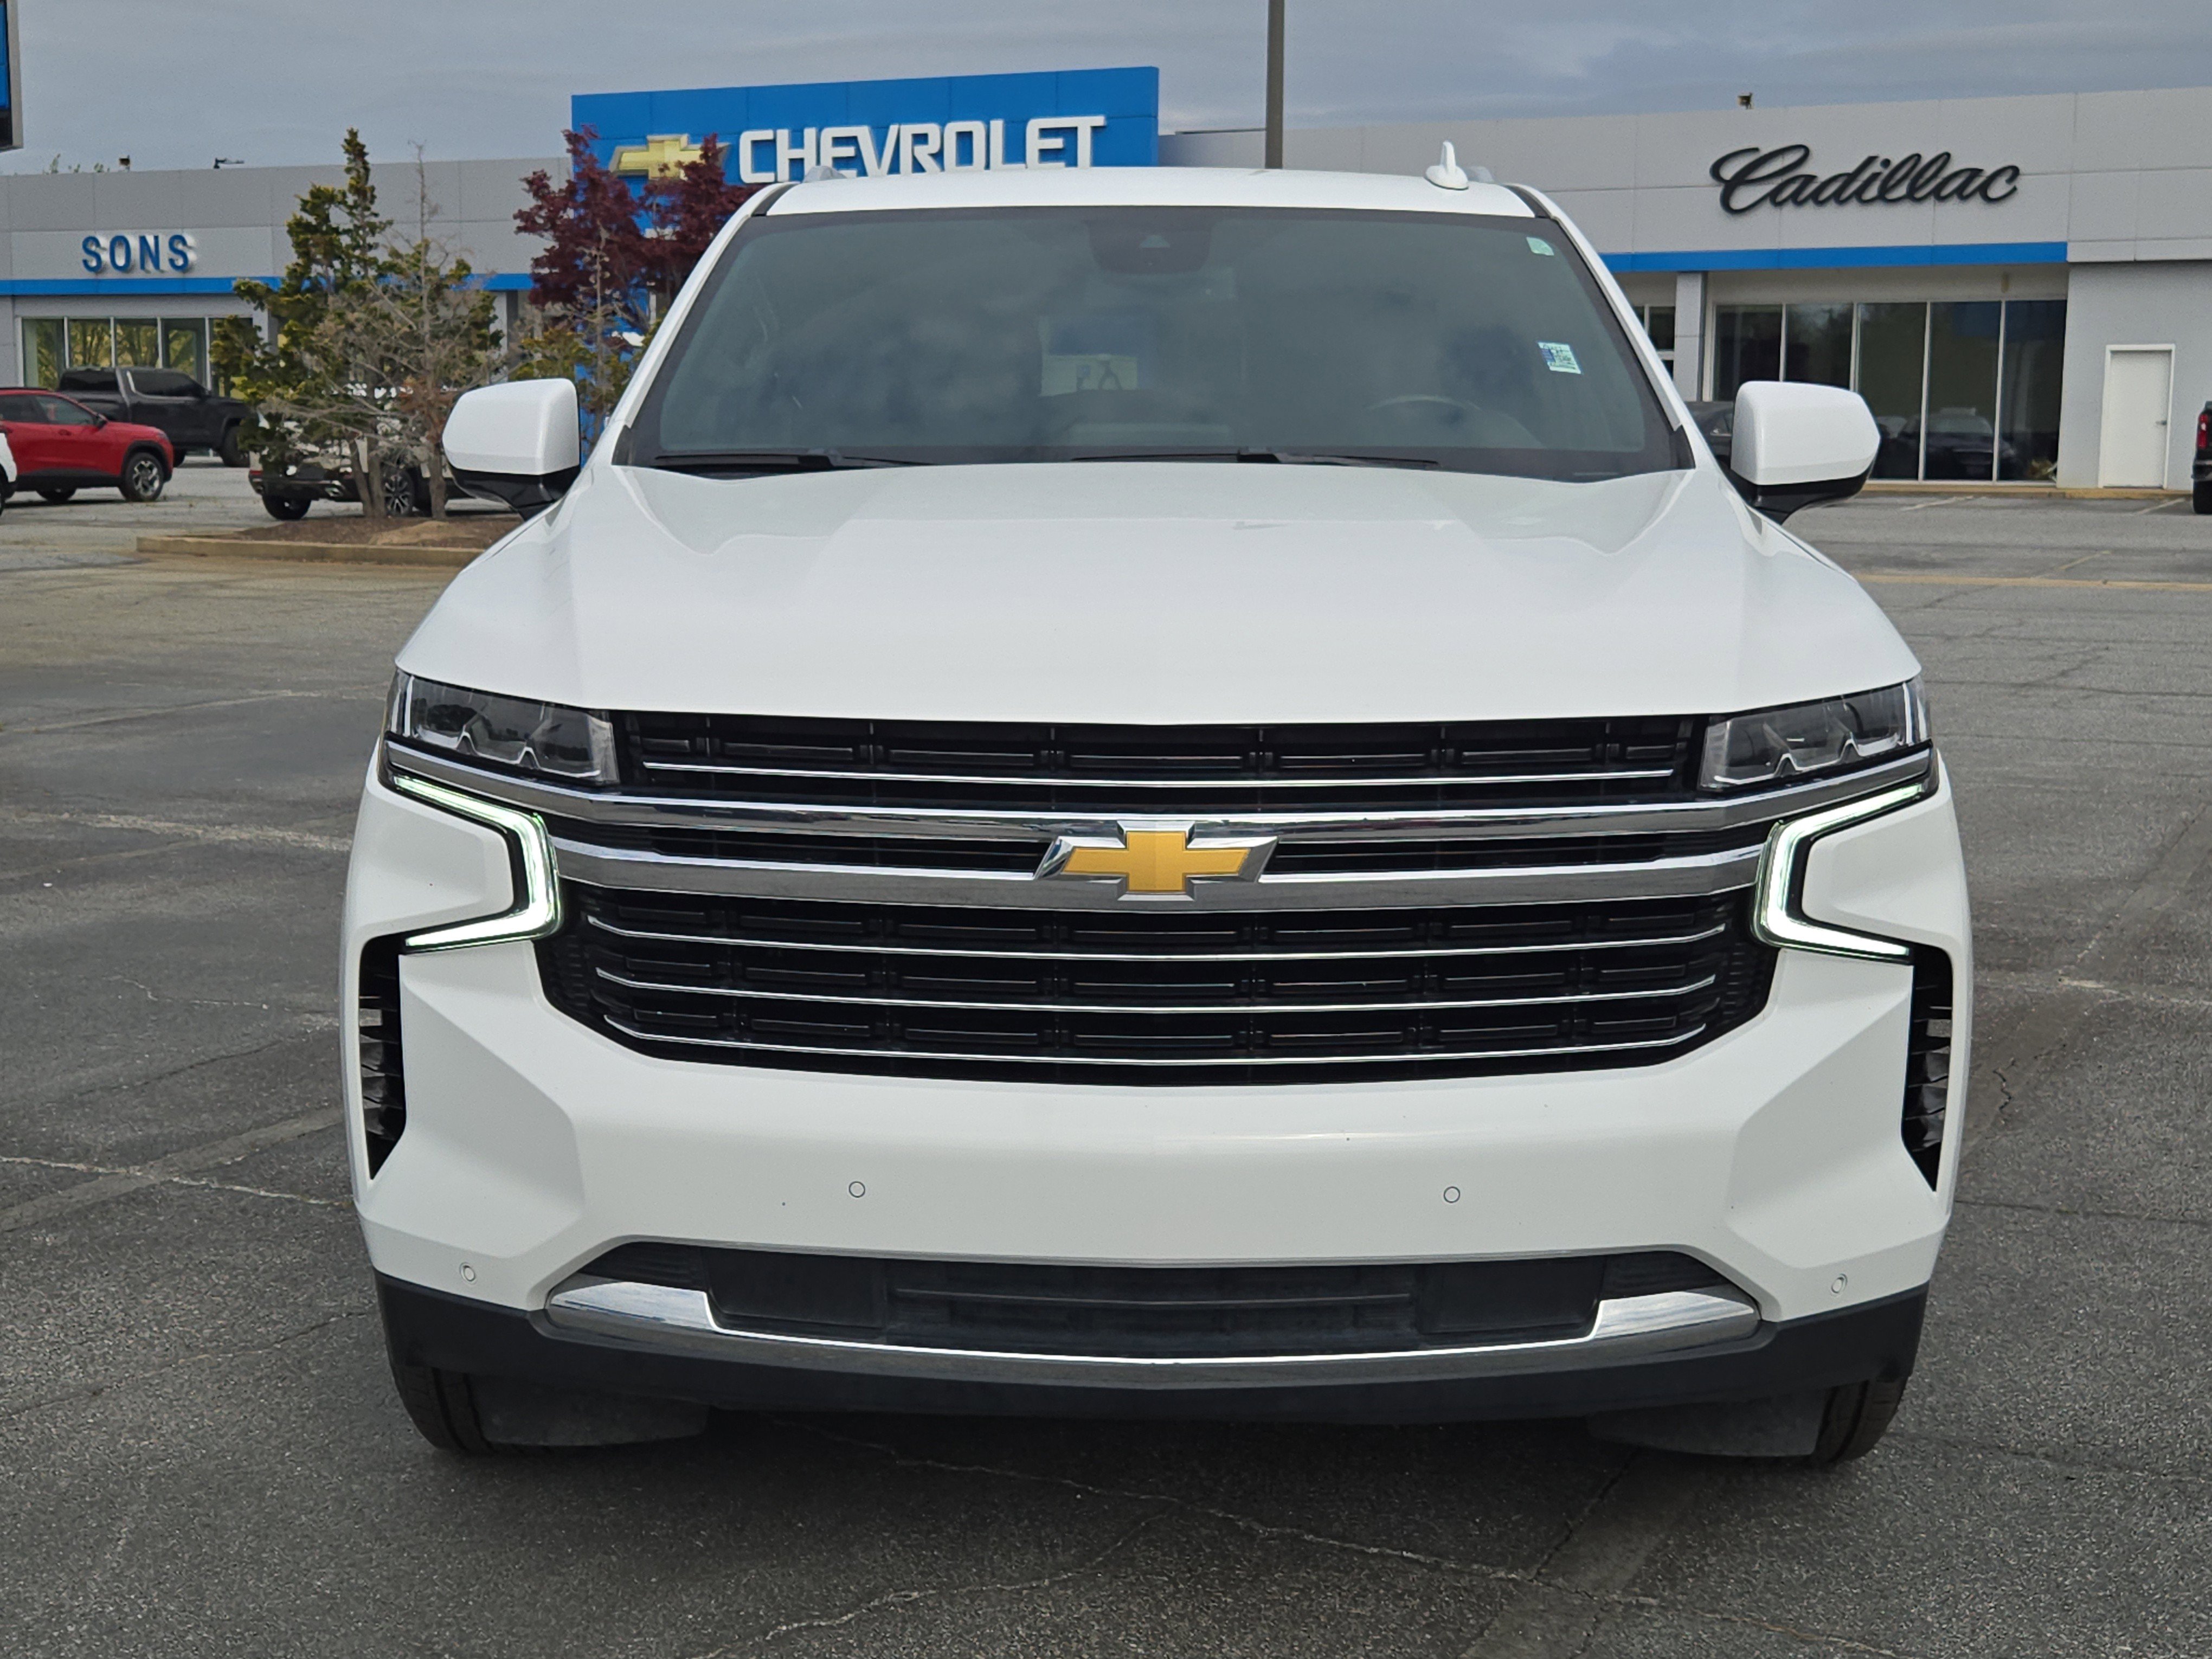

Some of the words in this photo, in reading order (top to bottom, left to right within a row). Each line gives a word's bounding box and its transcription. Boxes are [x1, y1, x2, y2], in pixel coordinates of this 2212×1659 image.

[740, 115, 1105, 183] CHEVROLET
[1709, 144, 2020, 214] Cadillac
[82, 234, 189, 272] SONS
